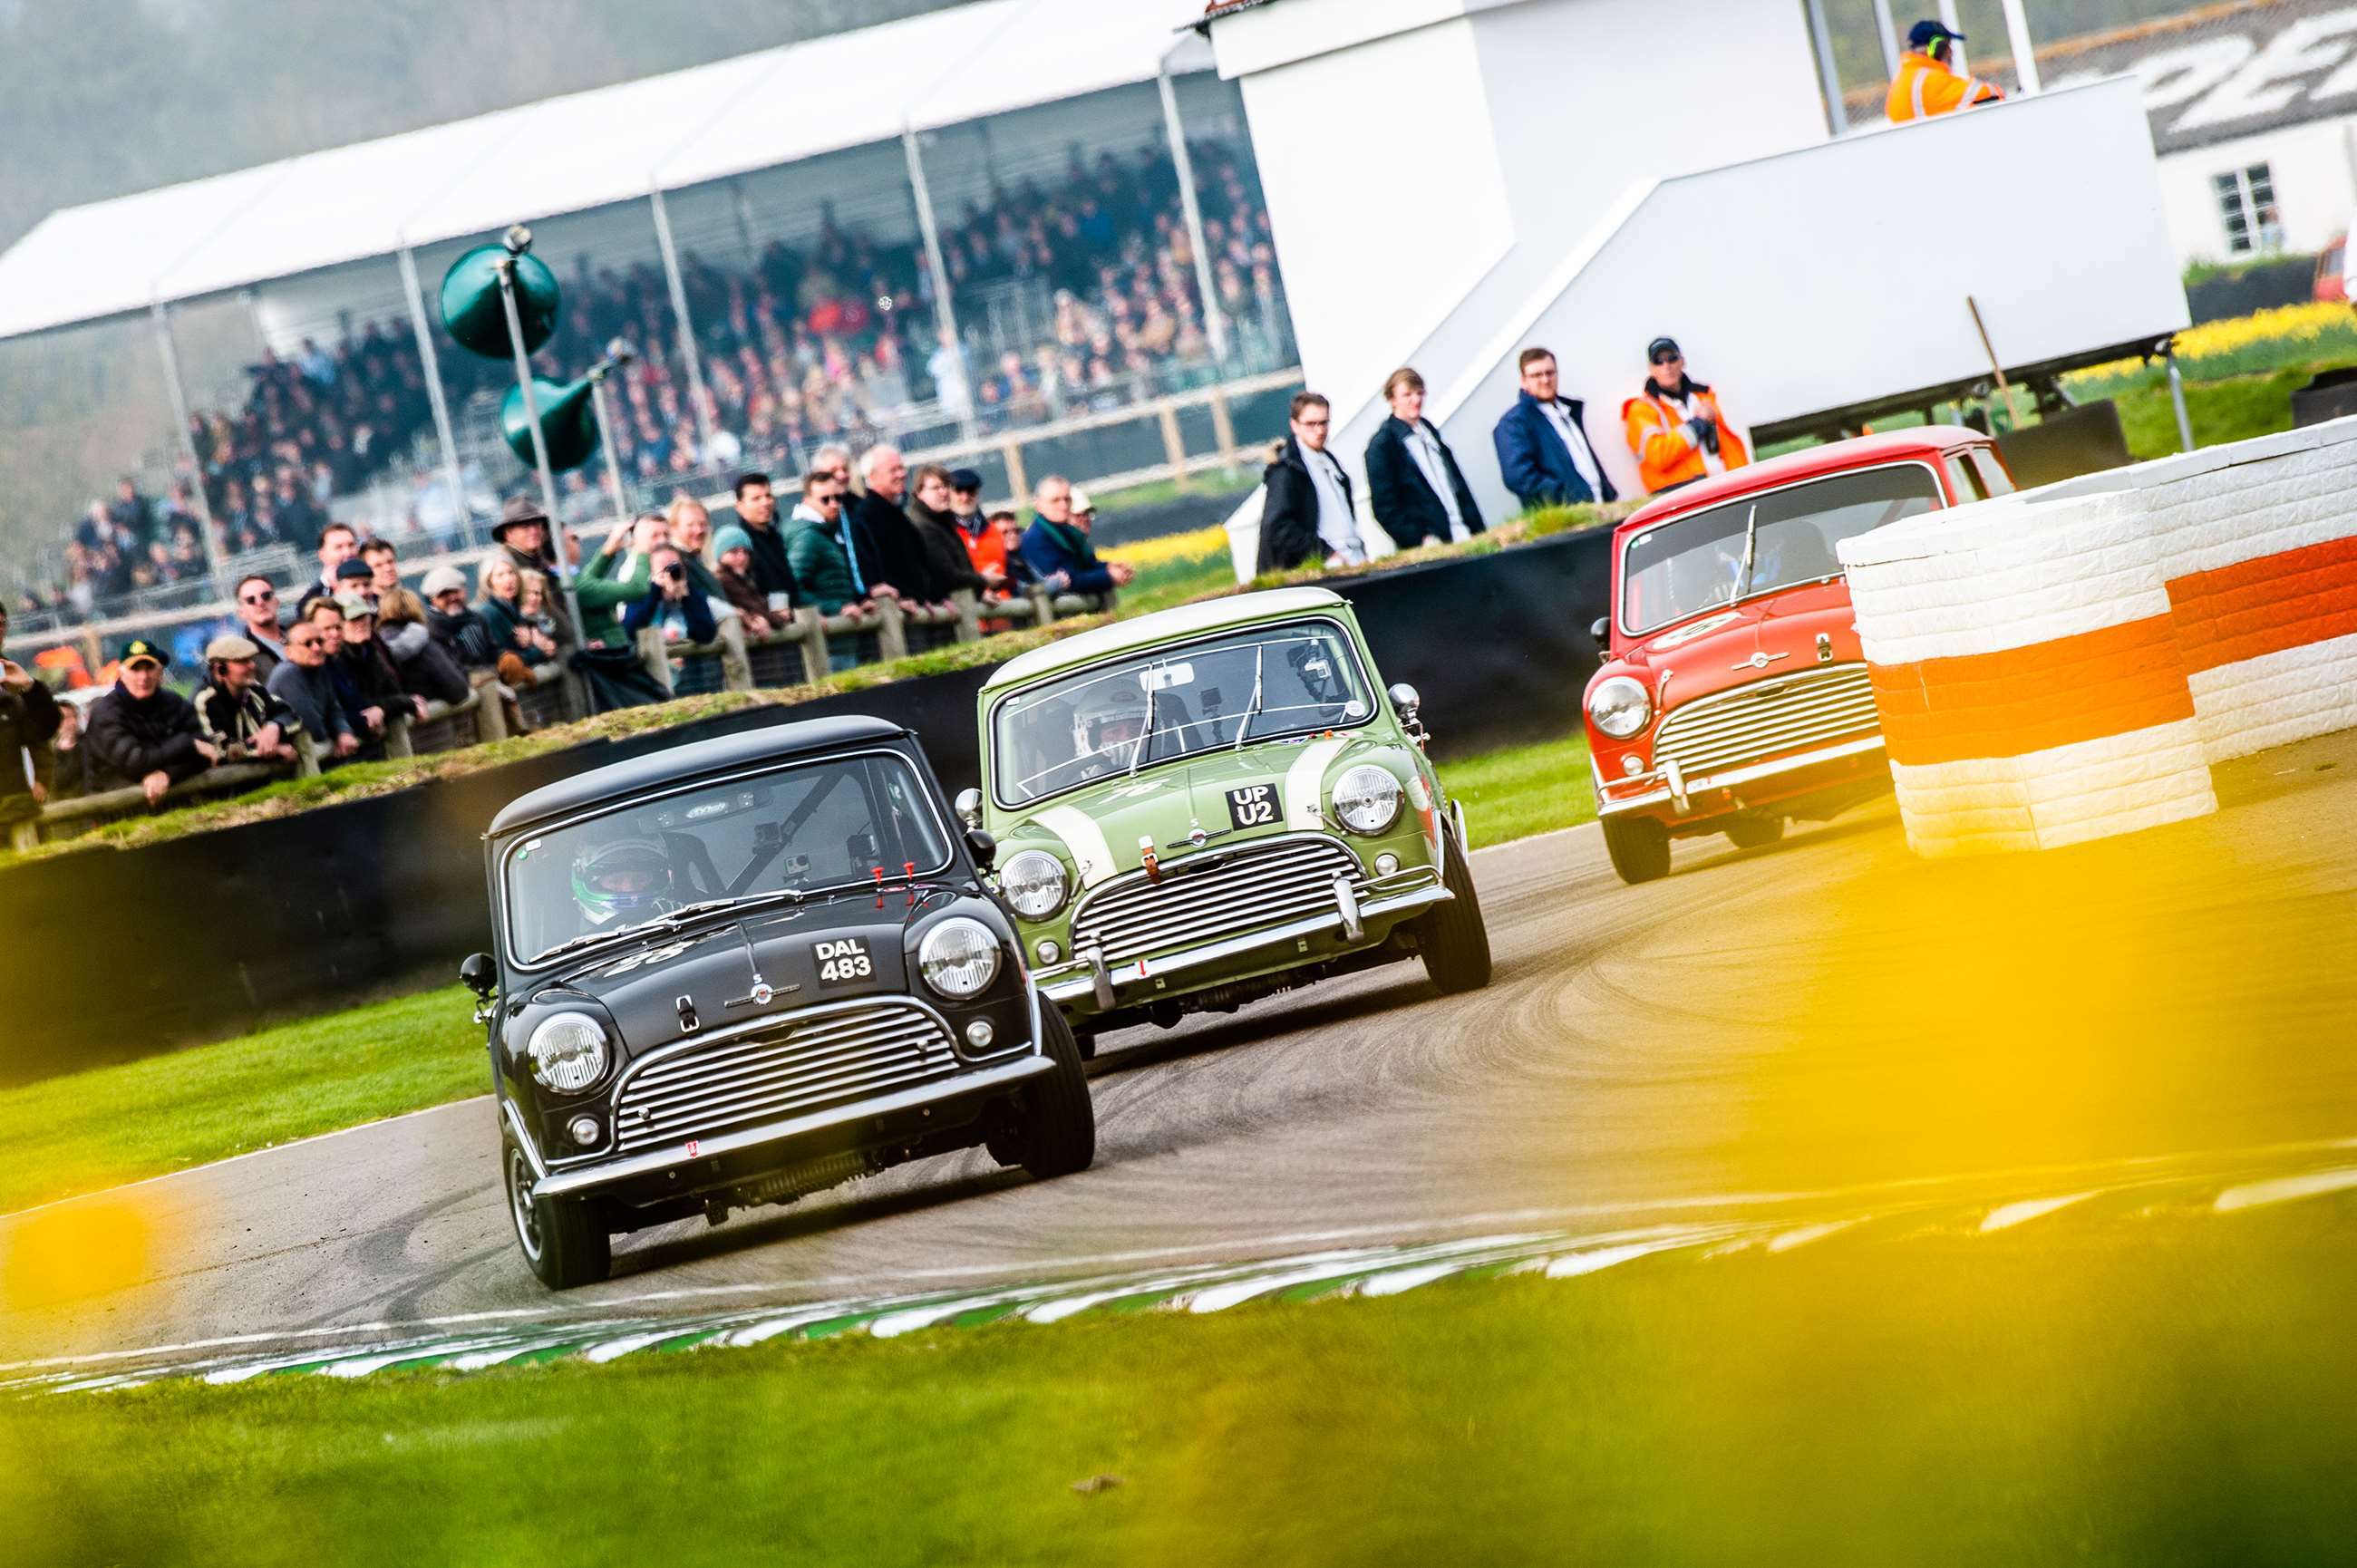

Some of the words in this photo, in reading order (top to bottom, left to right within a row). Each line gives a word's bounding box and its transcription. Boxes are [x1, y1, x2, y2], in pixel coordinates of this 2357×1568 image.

[1233, 786, 1269, 805] UP
[1237, 800, 1274, 826] U2
[815, 938, 866, 961] DAL
[752, 973, 762, 984] S
[820, 954, 871, 981] 483
